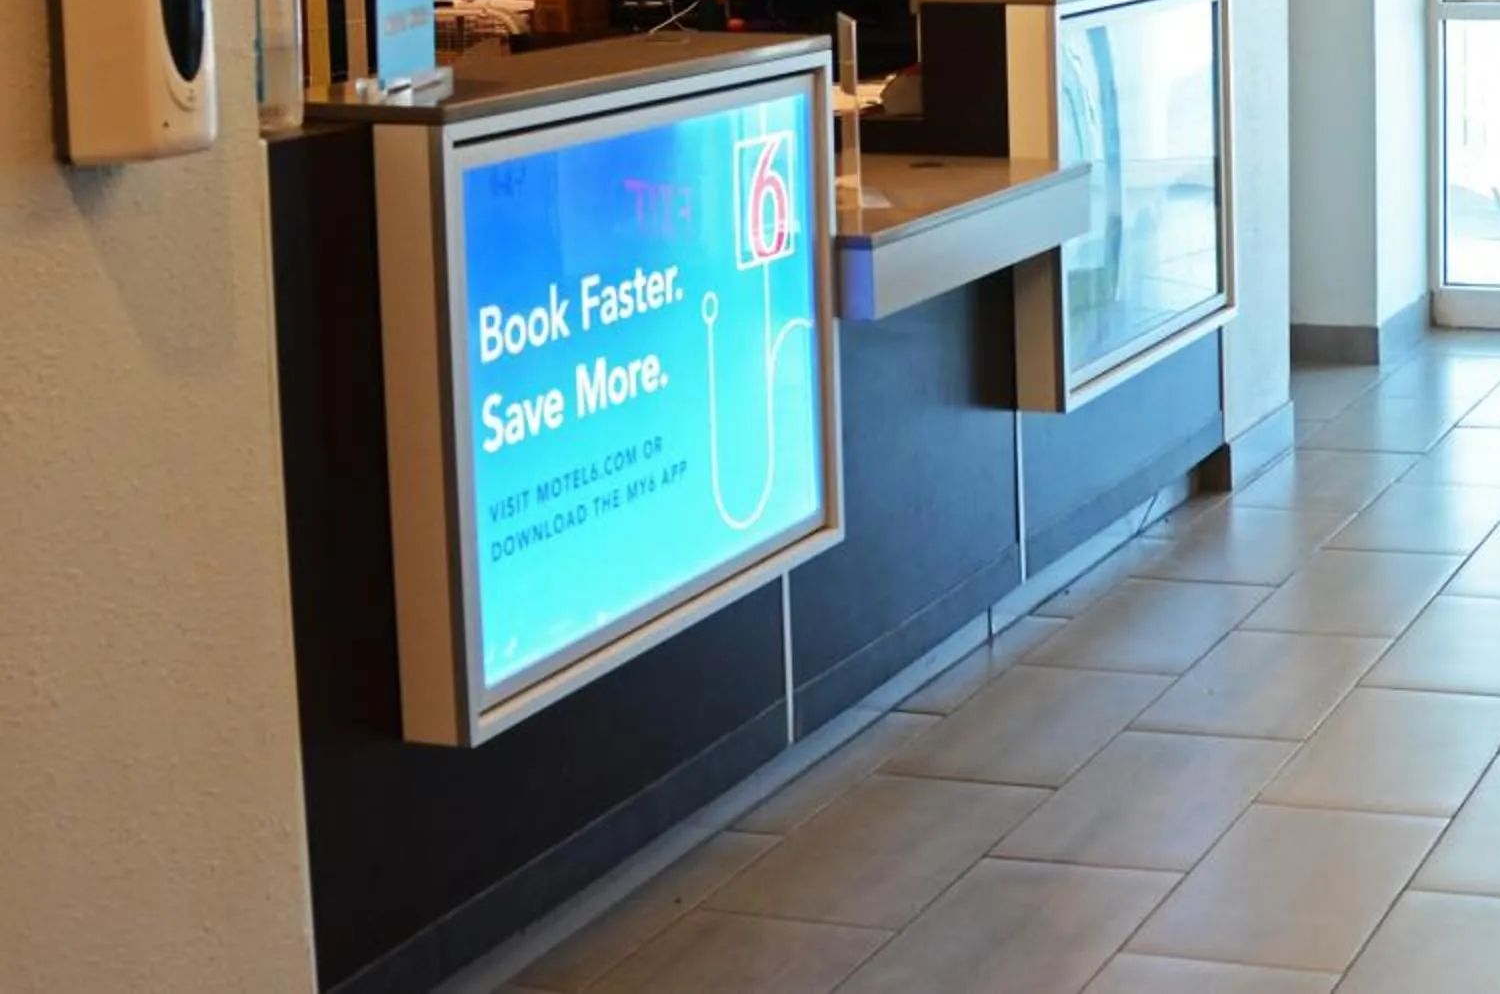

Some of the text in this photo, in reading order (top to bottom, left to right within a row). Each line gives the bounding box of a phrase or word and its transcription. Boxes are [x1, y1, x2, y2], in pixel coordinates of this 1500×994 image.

[748, 131, 790, 260] 6
[479, 265, 683, 364] Book Faster.
[481, 354, 669, 453] Save More.
[489, 435, 663, 523] VISIT MOTEL6.COM OR
[490, 459, 688, 563] DOWNLOAD THE MY6 APP
